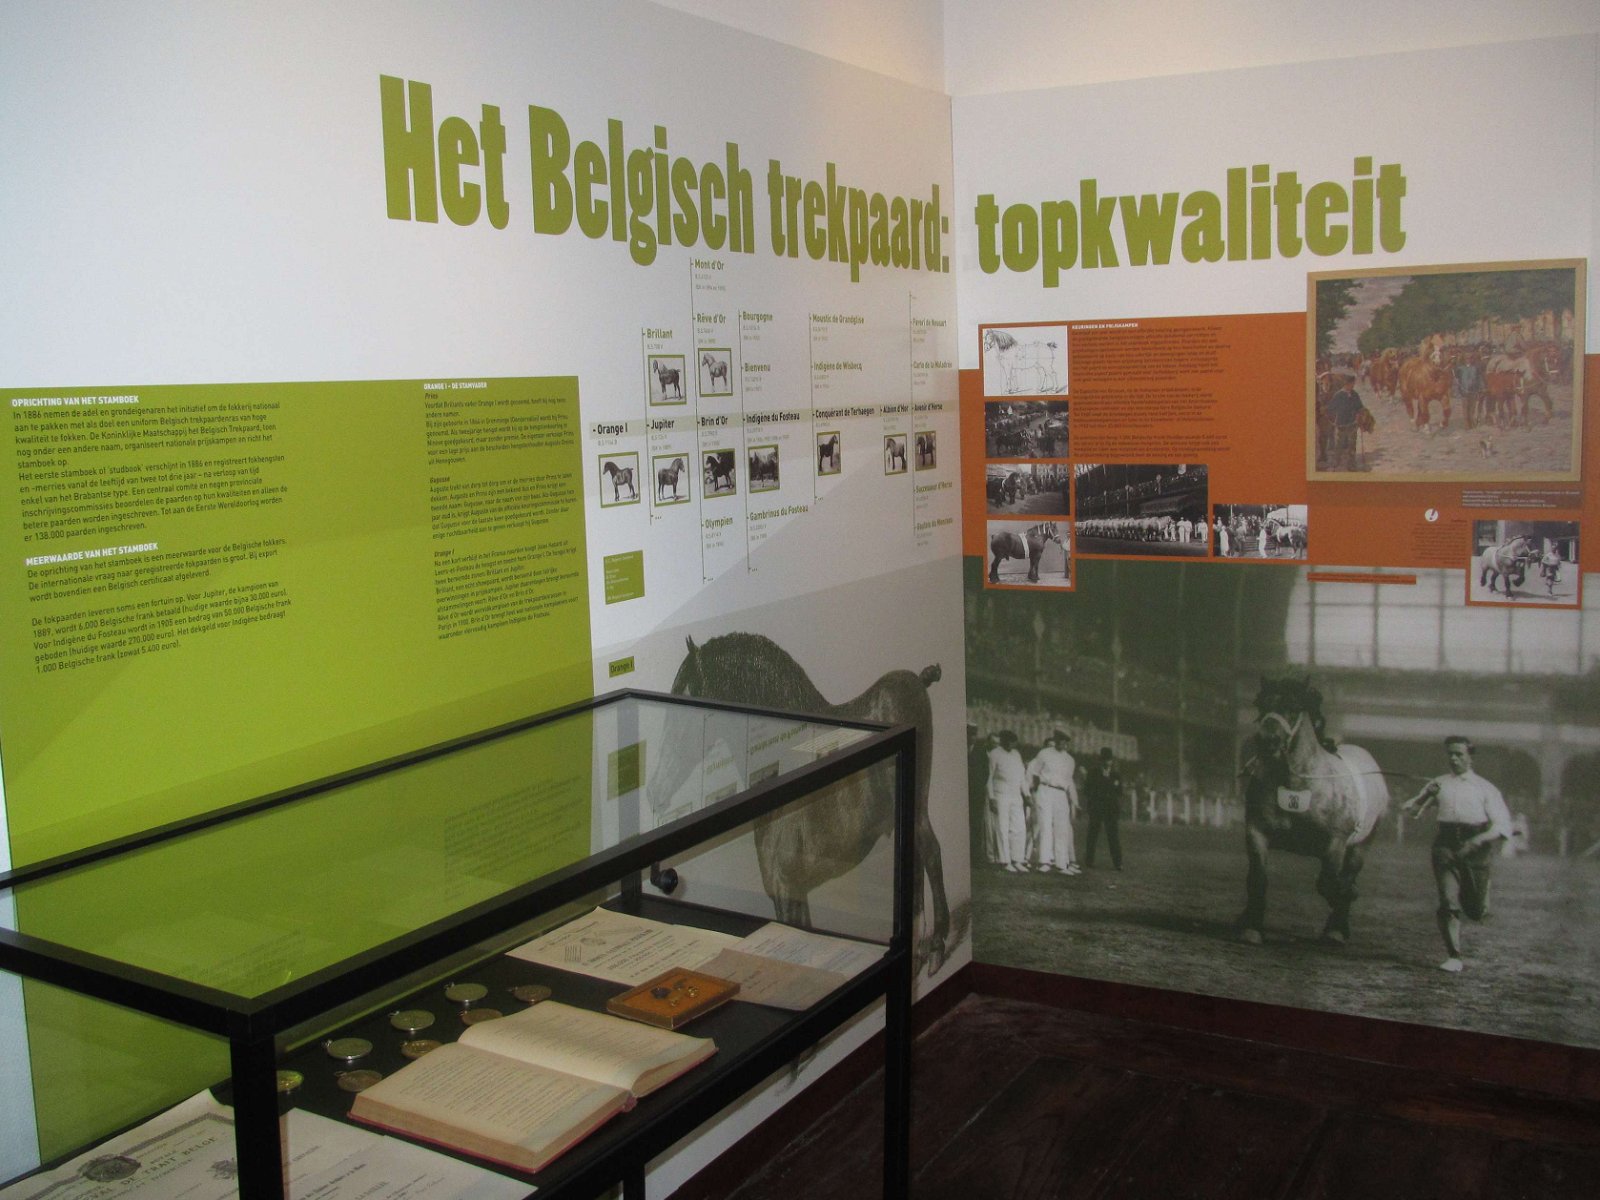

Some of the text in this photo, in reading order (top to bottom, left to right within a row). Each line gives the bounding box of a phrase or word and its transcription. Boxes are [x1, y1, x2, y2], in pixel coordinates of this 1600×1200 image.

[379, 73, 949, 283] Het Belgisch trekpaard:
[975, 156, 1407, 288] topkwaliteit
[695, 260, 724, 271] Mont d'Or
[697, 313, 726, 324] Rêve d'Or
[743, 313, 773, 323] Bourgogne
[812, 314, 831, 323] Moustic
[832, 315, 838, 323] de
[647, 328, 673, 339] Brillant
[745, 363, 770, 372] Bienvenu
[836, 362, 842, 370] de
[11, 395, 139, 406] OPRICHTING VAN HET STAMBOEK
[13, 411, 20, 420] In
[23, 410, 40, 419] 1886
[71, 409, 80, 417] de
[82, 408, 98, 417] adel
[111, 407, 165, 417] grondeigenaren
[166, 405, 176, 413] het
[179, 404, 205, 413] initiatief
[227, 403, 252, 412] fokkerij
[252, 402, 280, 410] nationaal
[816, 407, 875, 419] Conquérant de Terhaegen
[30, 423, 38, 431] te
[40, 421, 68, 432] pakken
[71, 420, 84, 429] met
[86, 420, 96, 428] als
[99, 419, 114, 427] doel
[130, 417, 158, 426] uniform
[160, 416, 188, 426] Belgisch
[189, 414, 238, 424] trekpaardenras
[251, 413, 266, 422] hoge
[701, 416, 728, 426] Brin d'Or
[746, 412, 800, 423] Indigène du Fosteau
[597, 425, 628, 435] Orange I
[651, 419, 675, 430] Jupiter
[15, 434, 48, 443] kwaliteit
[50, 433, 58, 442] te
[60, 432, 88, 441] fokken.
[89, 432, 99, 440] De
[101, 429, 141, 439] Koninklijke
[142, 427, 186, 437] Maatschappij
[188, 426, 199, 434] het
[200, 425, 227, 435] Belgisch
[228, 424, 261, 433] Trekpaard,
[16, 449, 31, 458] nog
[33, 446, 54, 455] onder
[73, 444, 98, 452] andere
[124, 439, 163, 451] organiseert
[165, 438, 196, 447] nationale
[197, 436, 237, 447] prijskampen
[247, 434, 261, 442] richt
[17, 459, 68, 468] stamboek op.
[750, 504, 809, 521] Gambrinus du Fosteau
[705, 516, 733, 530] Olympien
[34, 529, 64, 540] 138.000
[66, 527, 96, 539] paarden
[97, 523, 146, 535] ingeschreven.
[25, 542, 158, 566] MEERWAARDE VAN HET STAMBOEK
[27, 569, 37, 578] De
[39, 564, 78, 578] oprichting
[79, 563, 92, 571] van
[94, 559, 106, 569] het
[107, 555, 141, 567] stamboek
[143, 554, 150, 562] is
[165, 547, 206, 559] meerwaarde
[222, 544, 231, 552] de
[232, 540, 261, 551] Belgische
[262, 538, 286, 547] fokkers.
[29, 591, 51, 602] wordt
[53, 586, 91, 598] bovendien
[108, 578, 137, 591] Belgisch
[139, 574, 173, 586] certificaat
[175, 569, 211, 582] afgeleverd.
[610, 663, 629, 673] Orange
[184, 1136, 217, 1156] BELGE
